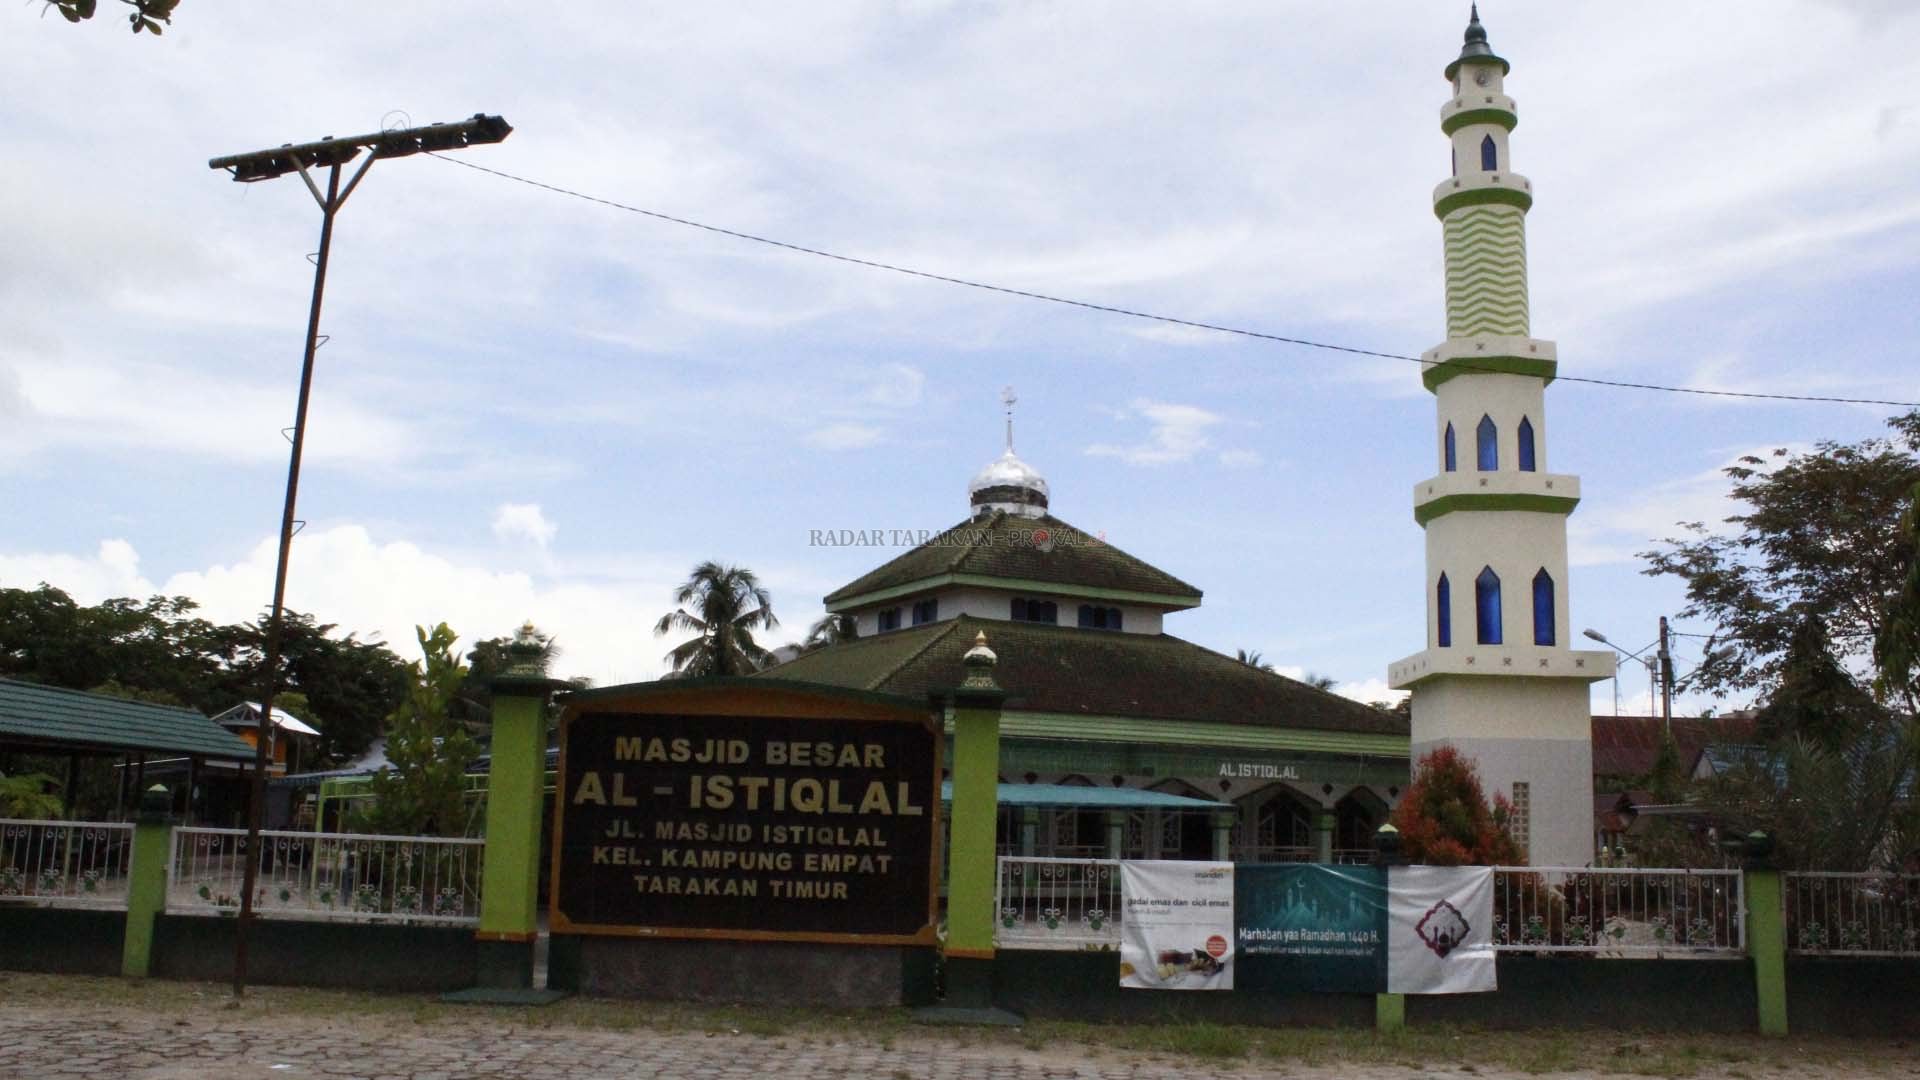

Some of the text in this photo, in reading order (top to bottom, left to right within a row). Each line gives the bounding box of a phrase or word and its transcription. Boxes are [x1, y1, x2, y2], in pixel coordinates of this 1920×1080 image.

[615, 736, 885, 767] MASJID BESAR
[1219, 763, 1236, 777] AL
[574, 771, 638, 806] AL
[690, 774, 924, 817] ISTIQLAL
[605, 820, 888, 847] JL. MASJID ISTIQLAL
[593, 845, 893, 873] KEL. KAMPUNG EMPAT
[634, 875, 848, 899] TARAKAN TIMUR
[1173, 898, 1188, 906] dan
[1239, 927, 1282, 940] Marhaban
[1285, 930, 1299, 942] yaa
[1301, 928, 1345, 941] Ramadhan
